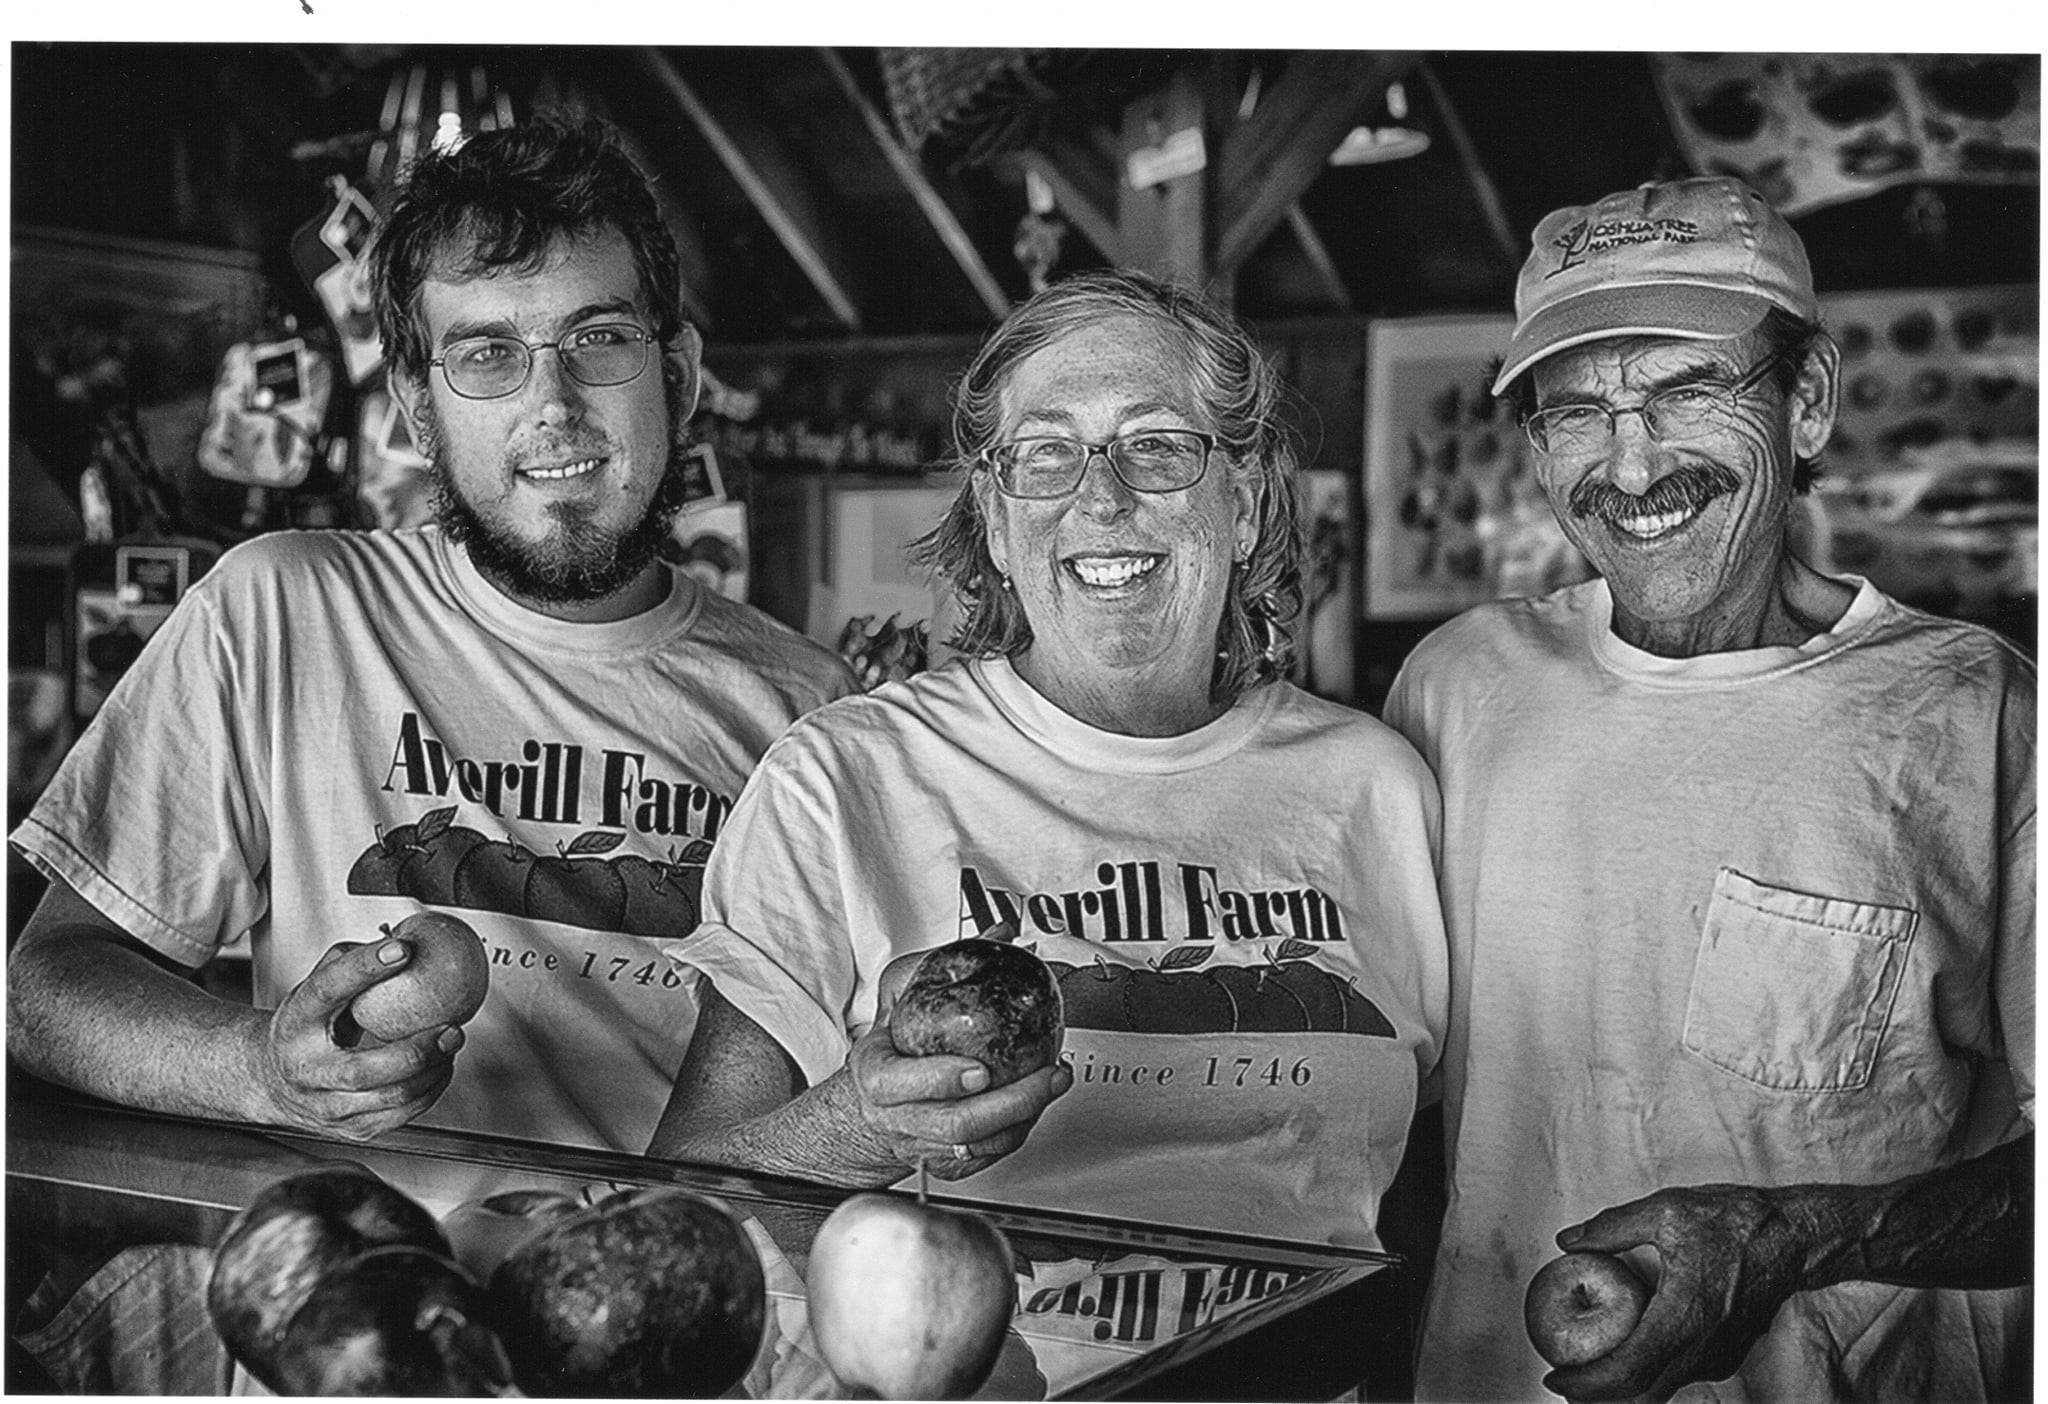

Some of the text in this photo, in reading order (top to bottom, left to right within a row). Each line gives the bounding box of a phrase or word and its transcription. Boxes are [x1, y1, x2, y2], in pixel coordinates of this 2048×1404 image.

[1587, 231, 1698, 252] NATIONAL PARK
[1655, 218, 1699, 235] TREE
[381, 712, 584, 825] Averill
[958, 860, 1348, 943] Averill Farm
[482, 937, 682, 989] nce 1746
[1058, 1052, 1312, 1087] Since 1746
